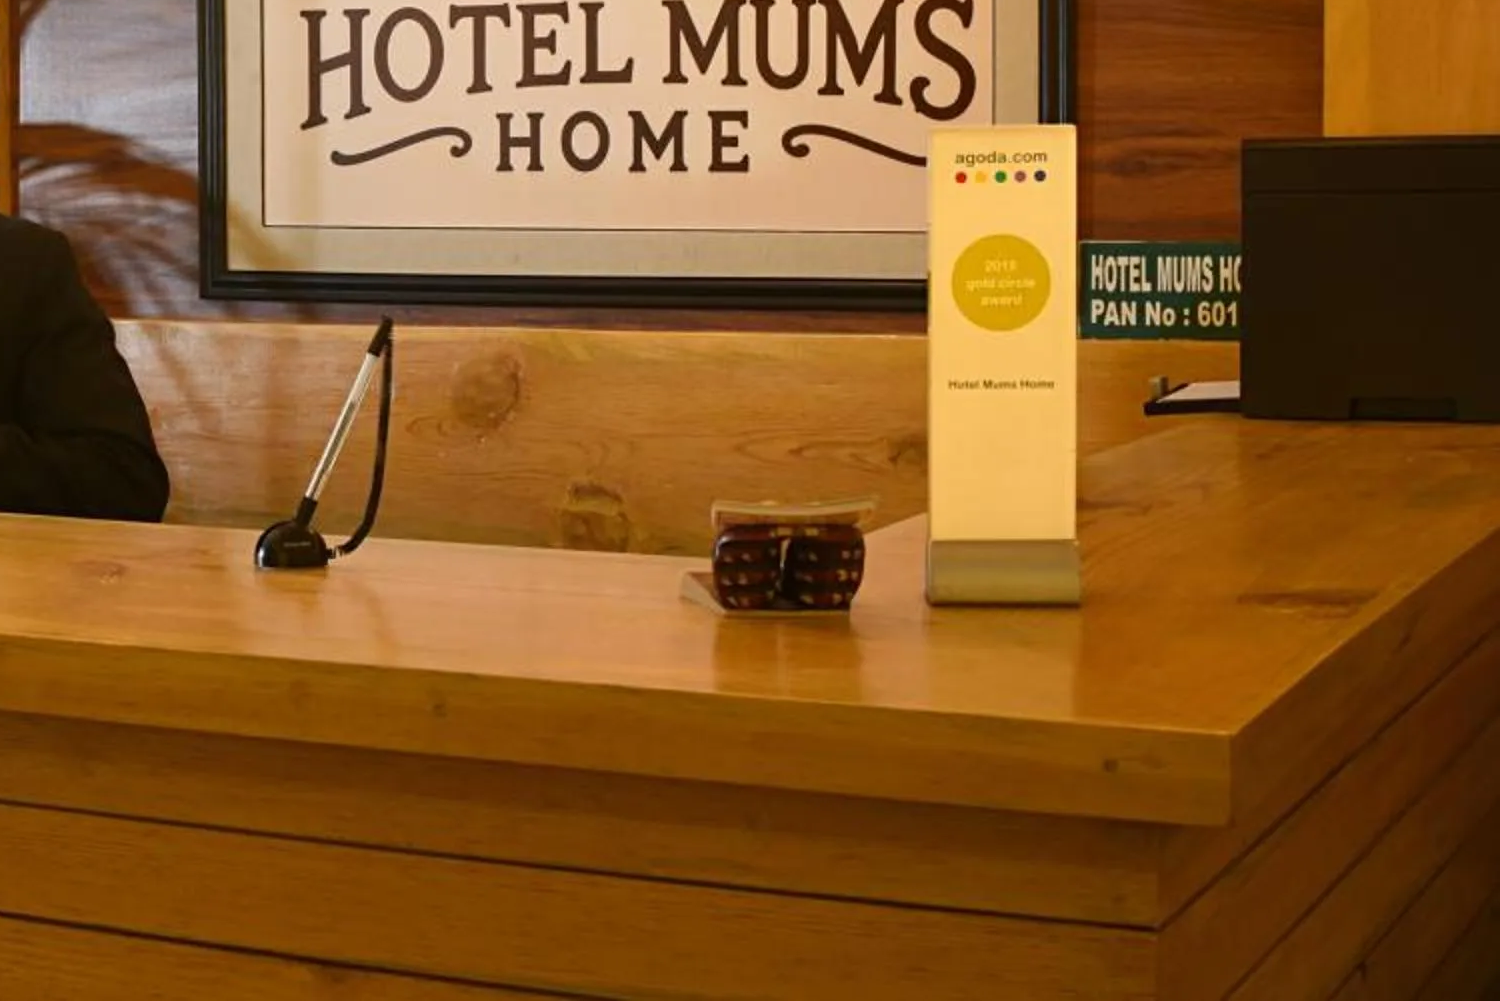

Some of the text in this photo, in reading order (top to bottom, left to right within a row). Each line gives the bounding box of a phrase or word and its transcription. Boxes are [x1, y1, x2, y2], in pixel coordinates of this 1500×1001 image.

[299, 1, 634, 130] HOTEL
[495, 110, 750, 172] HOME
[955, 150, 1048, 168] agoda.com
[1090, 254, 1152, 293] HOTEL
[1156, 255, 1214, 294] MUMS
[1090, 299, 1138, 327] PAN
[1144, 301, 1177, 327] No
[1197, 300, 1238, 328] 601
[947, 378, 1056, 390] Hotel Mums Home
